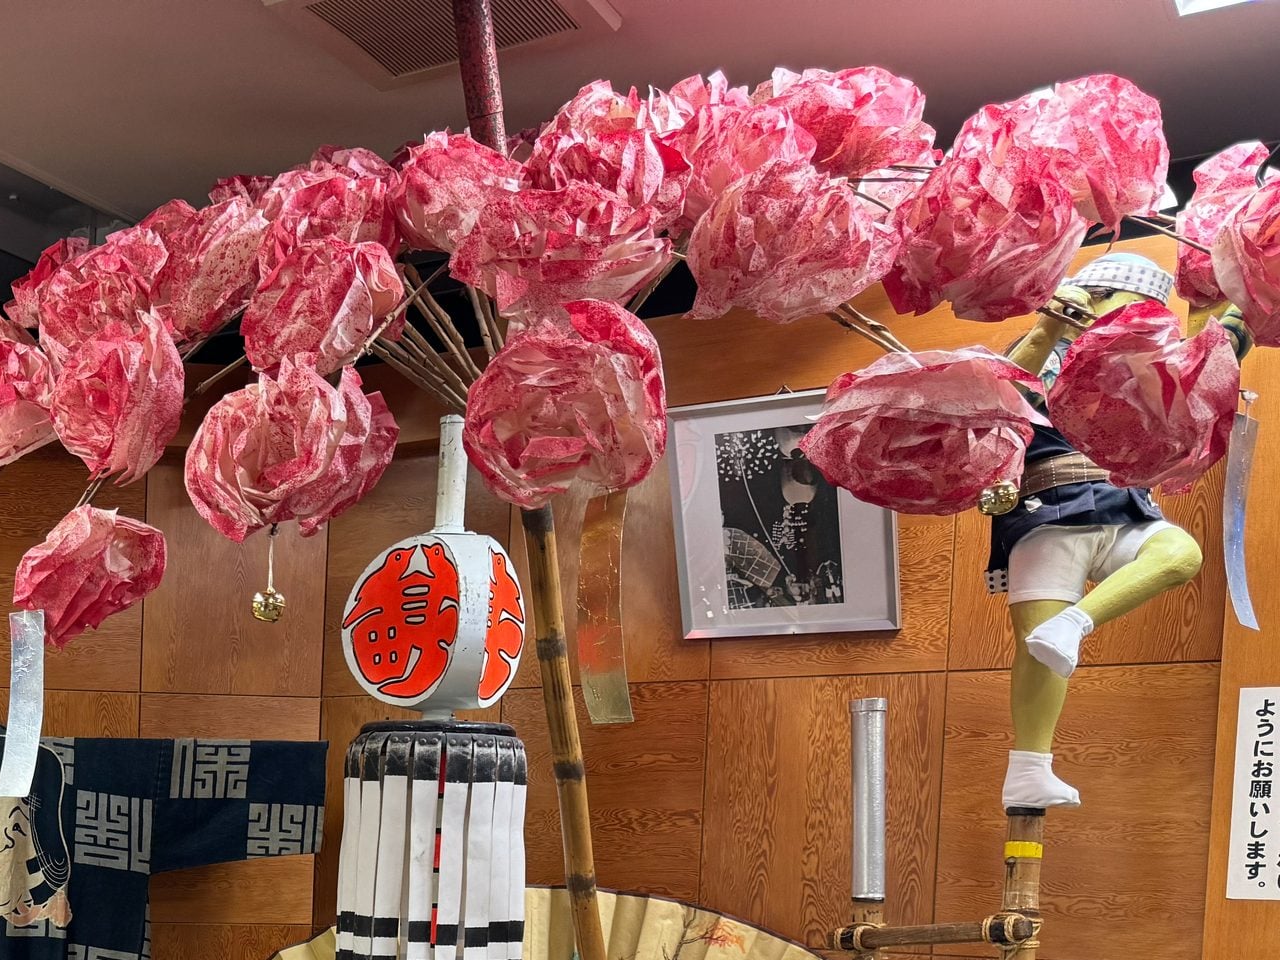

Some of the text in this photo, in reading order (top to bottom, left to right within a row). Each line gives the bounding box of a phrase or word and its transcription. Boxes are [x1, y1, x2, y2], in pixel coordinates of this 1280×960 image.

[1245, 699, 1276, 888] ようにお願いします。
